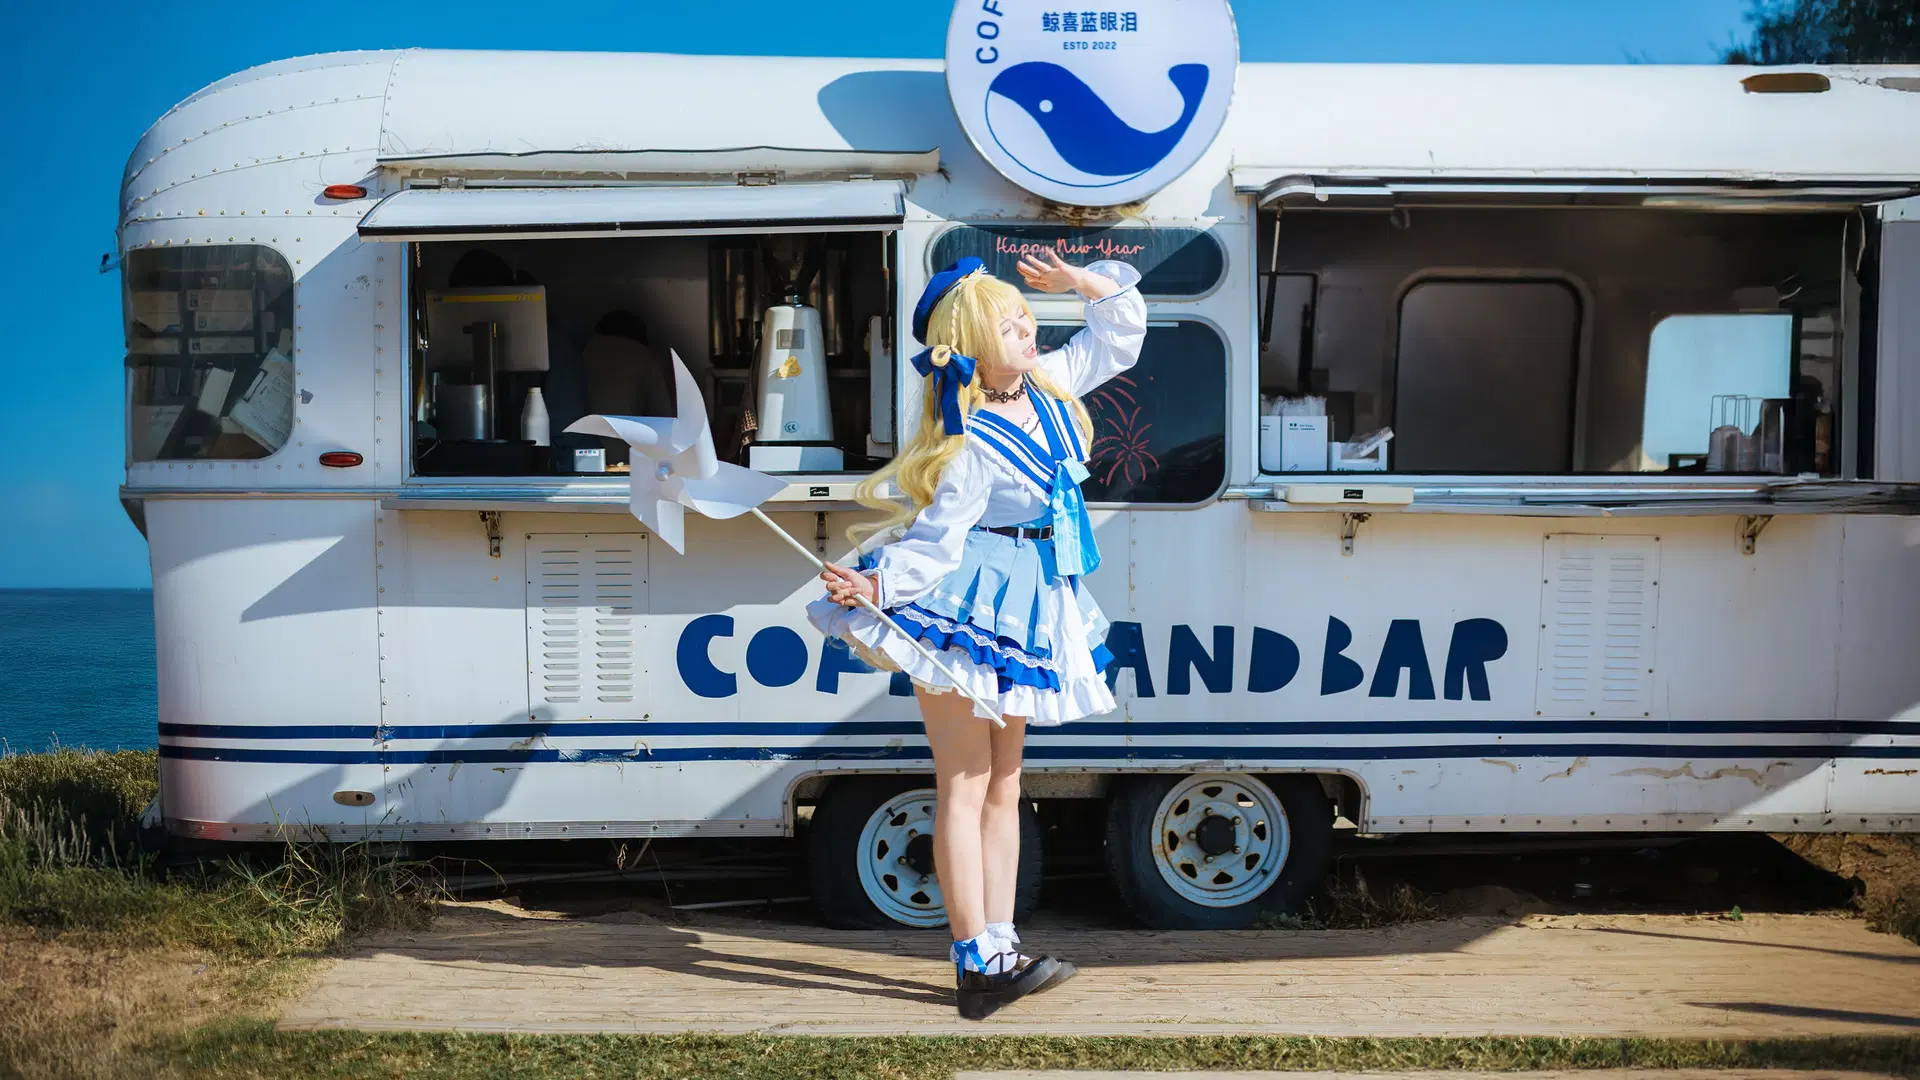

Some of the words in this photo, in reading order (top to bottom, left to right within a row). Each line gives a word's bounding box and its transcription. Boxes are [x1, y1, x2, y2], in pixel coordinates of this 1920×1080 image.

[1042, 11, 1137, 32] 鲸喜蓝眼泪
[1063, 41, 1088, 50] ESTD
[1092, 41, 1117, 50] 2022
[1057, 237, 1094, 254] New
[1095, 238, 1145, 258] Year
